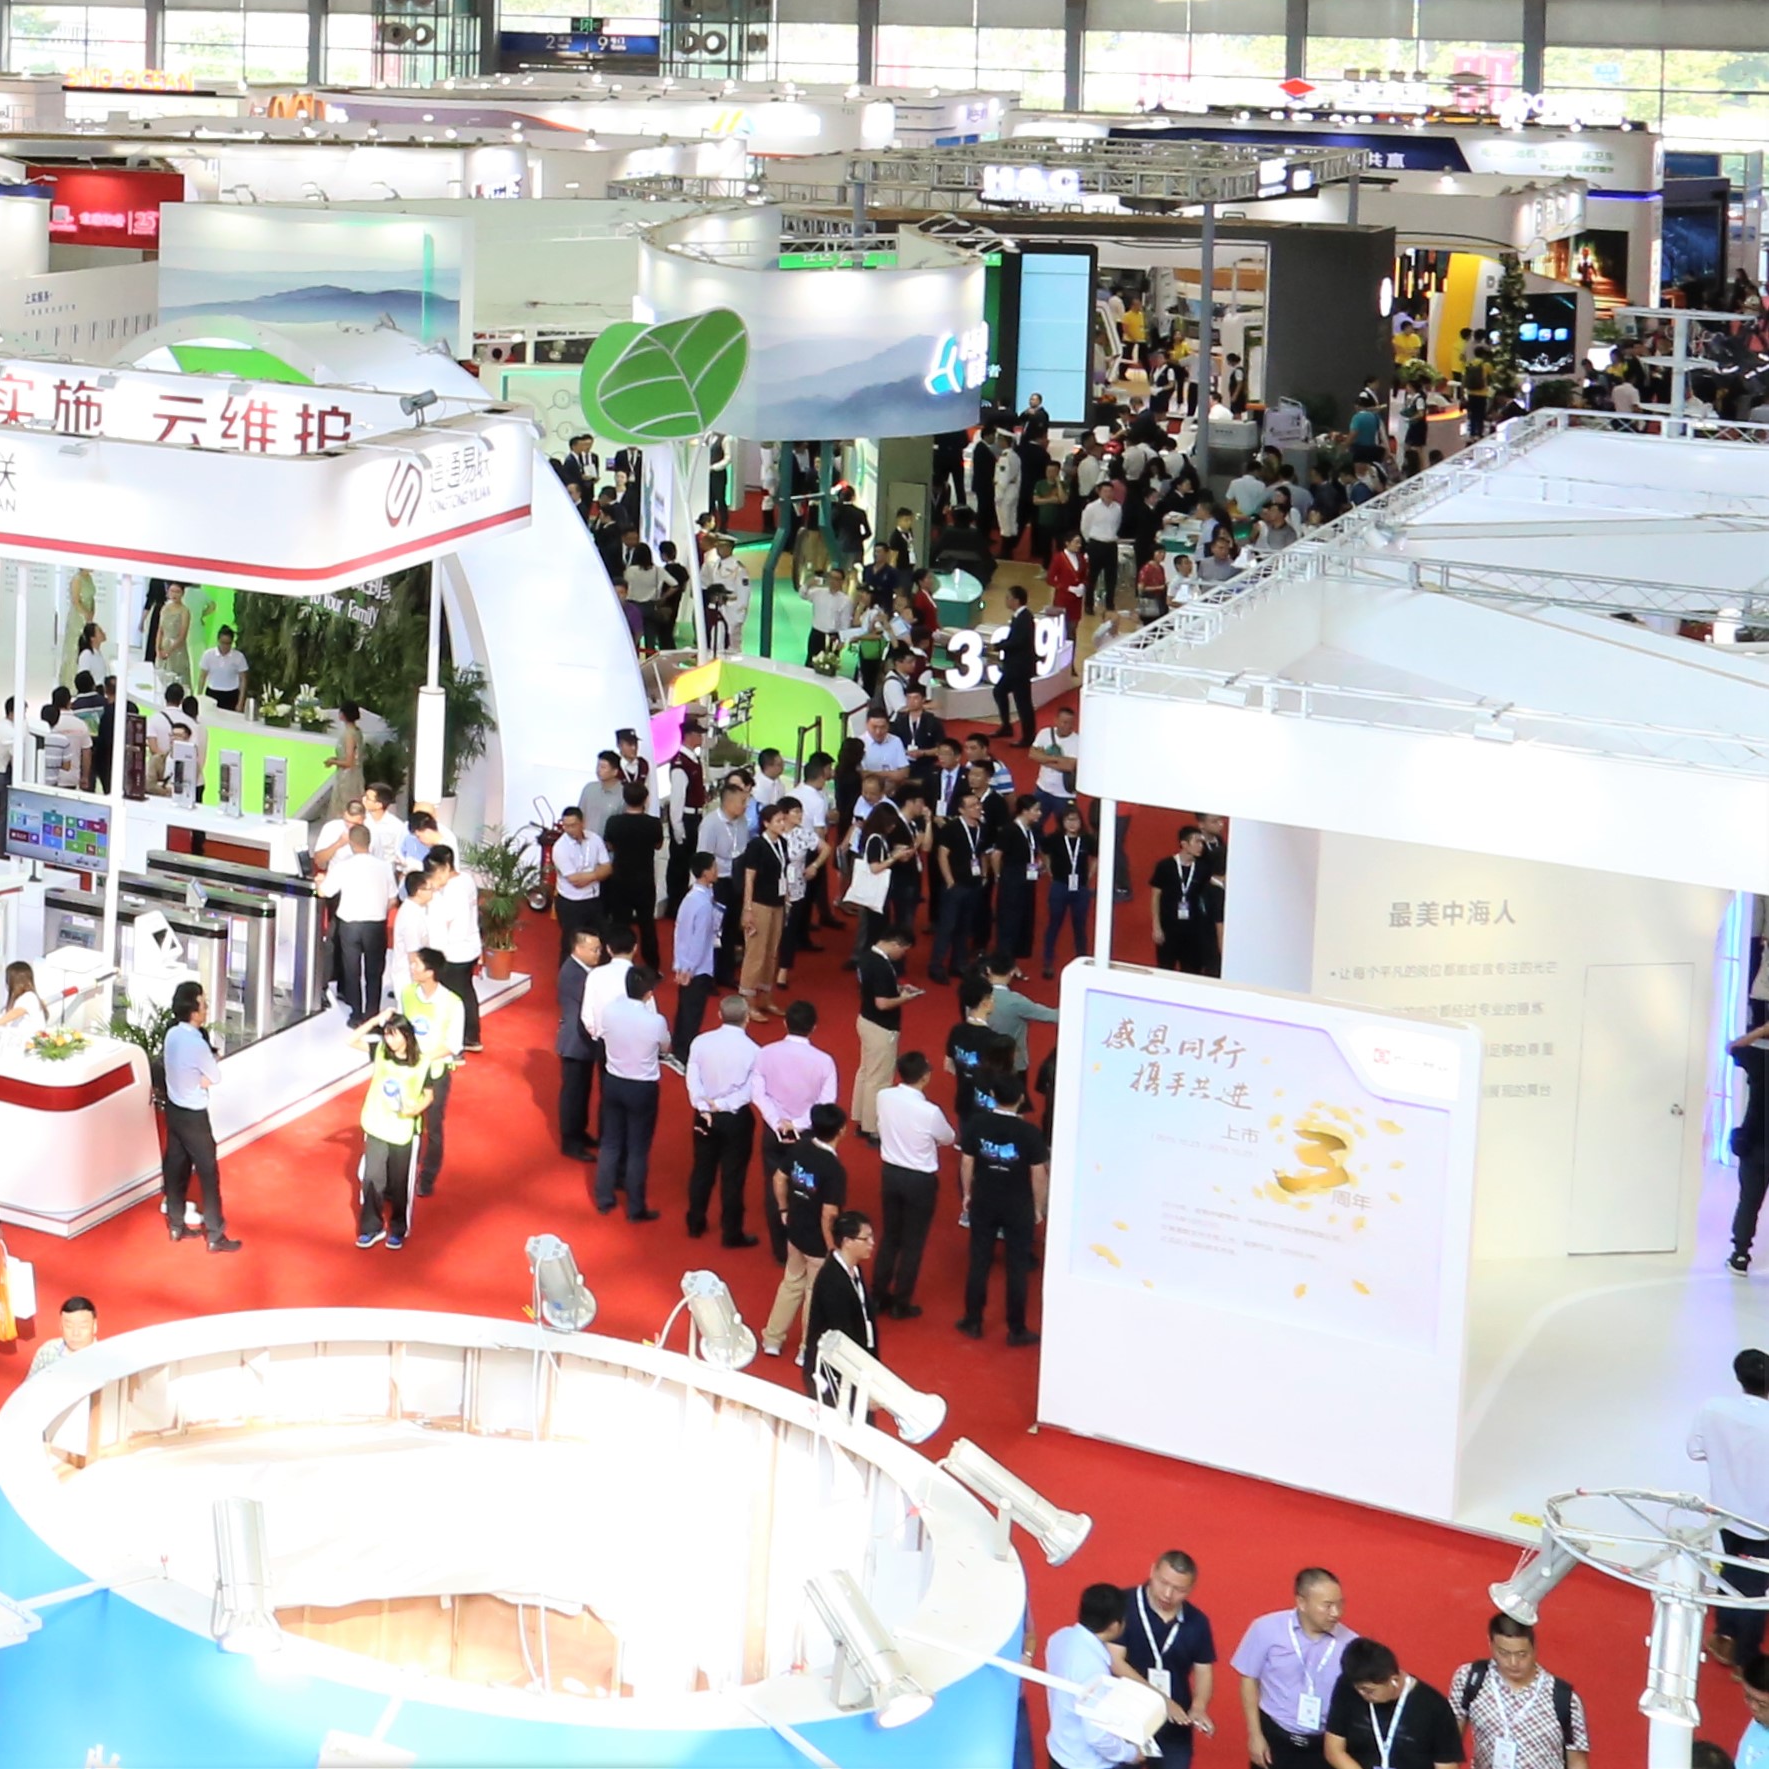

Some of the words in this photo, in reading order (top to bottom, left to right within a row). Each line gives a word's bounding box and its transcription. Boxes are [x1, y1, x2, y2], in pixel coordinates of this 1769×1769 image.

[348, 595, 379, 628] Family
[1387, 900, 1517, 930] 最美中海人
